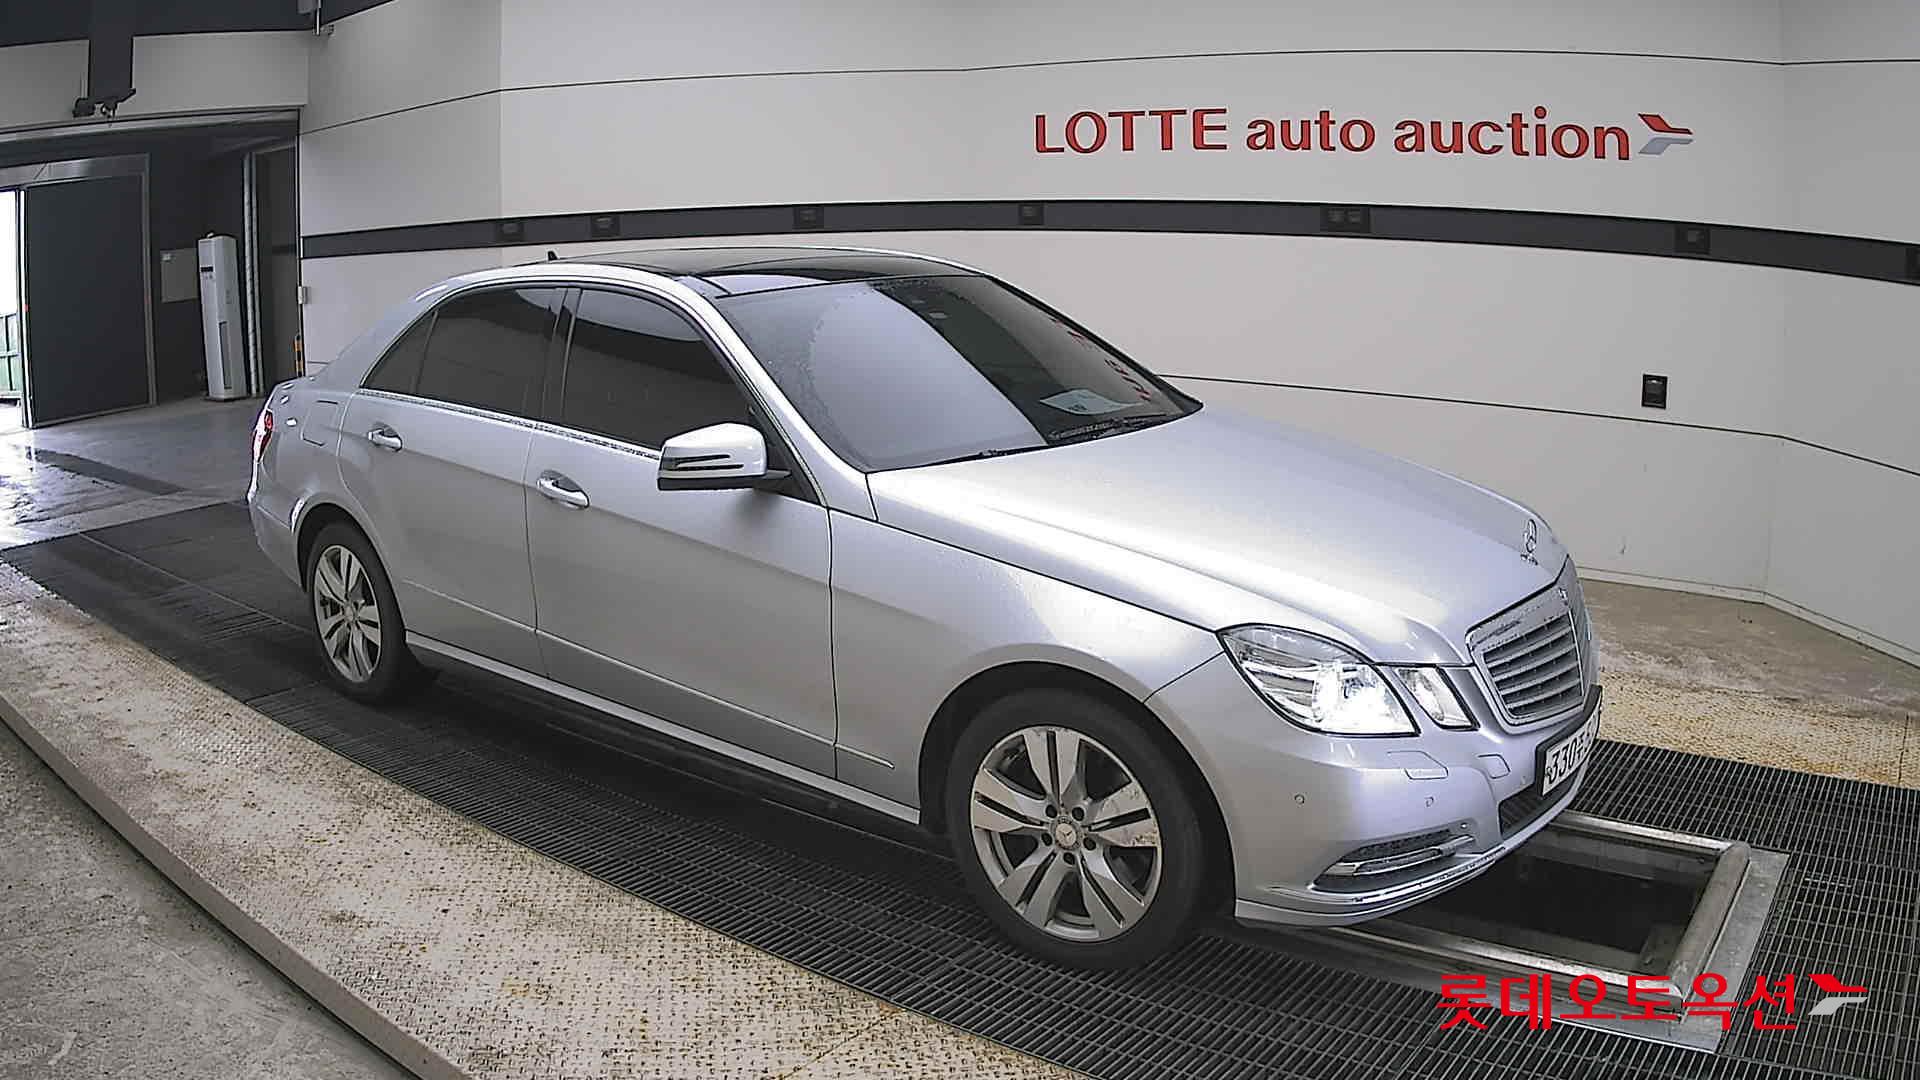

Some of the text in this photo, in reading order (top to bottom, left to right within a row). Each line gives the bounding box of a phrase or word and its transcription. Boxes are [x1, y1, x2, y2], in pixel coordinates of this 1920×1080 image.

[1035, 105, 1630, 161] LOTTE auto auction
